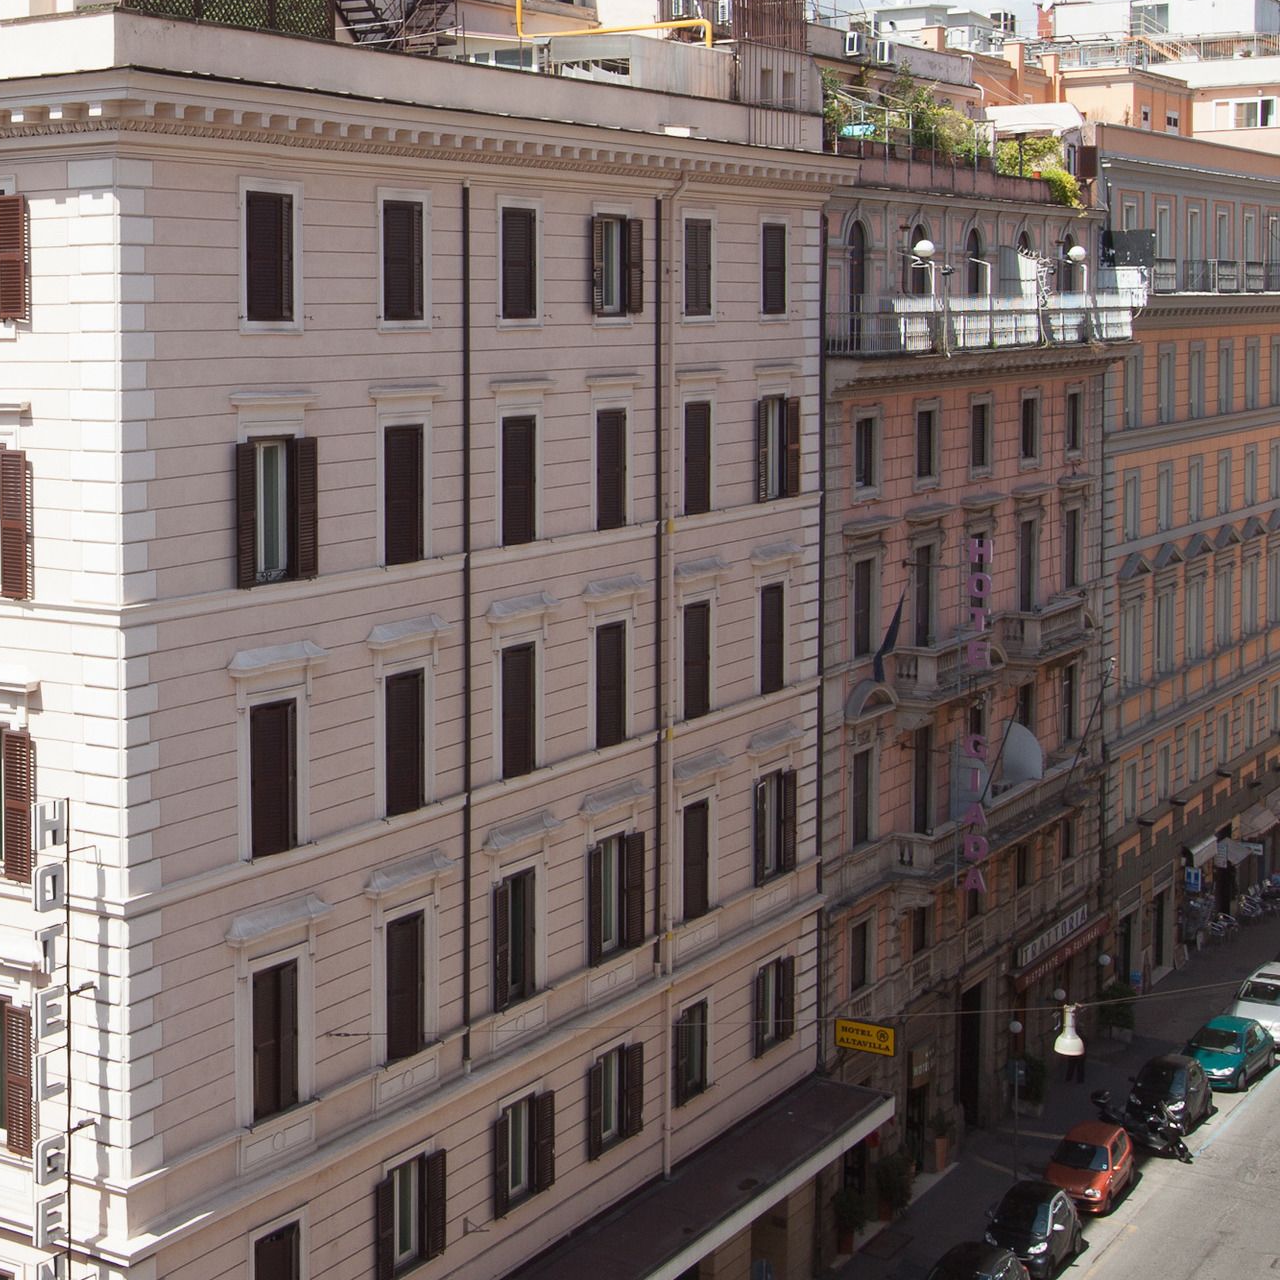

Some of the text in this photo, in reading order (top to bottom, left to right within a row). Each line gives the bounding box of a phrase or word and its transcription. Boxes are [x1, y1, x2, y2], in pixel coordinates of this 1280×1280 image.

[963, 733, 989, 894] GIADA
[31, 797, 67, 1103] HOTEL
[1023, 908, 1087, 964] TRATTORIA
[839, 1036, 890, 1052] ALTAVILLA
[841, 1026, 873, 1038] HOTEL
